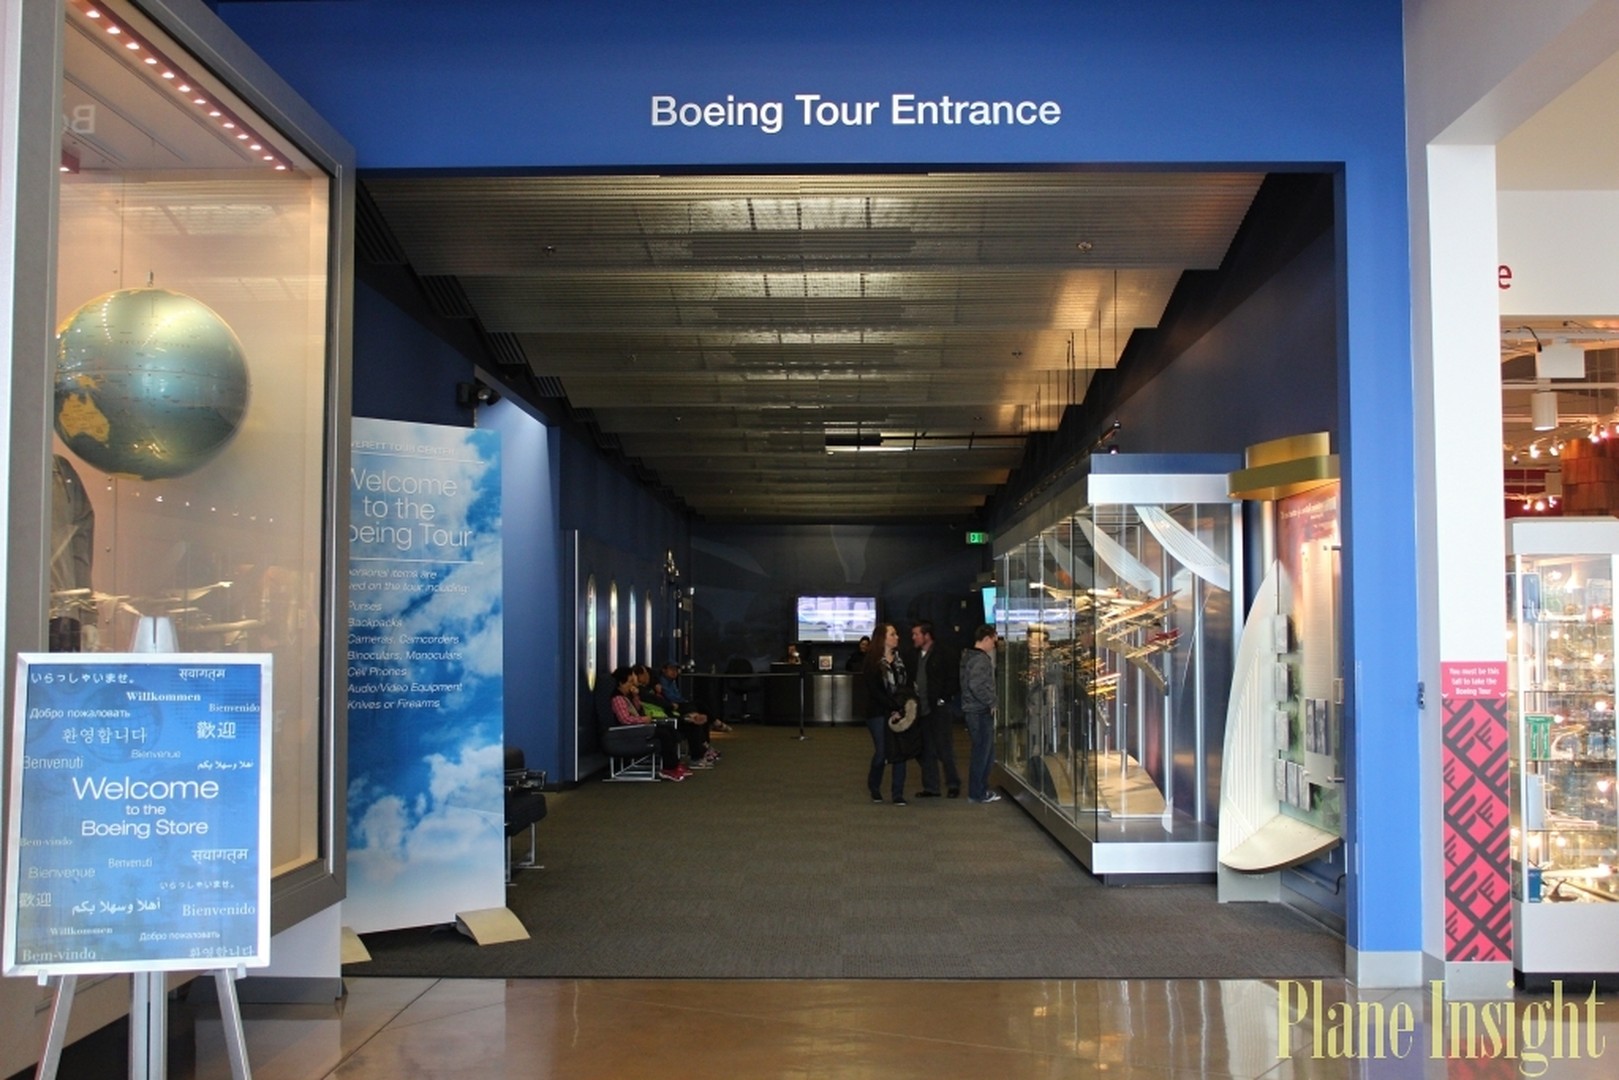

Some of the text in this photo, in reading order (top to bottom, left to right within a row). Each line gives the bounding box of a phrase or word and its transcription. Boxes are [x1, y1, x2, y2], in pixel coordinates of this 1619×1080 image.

[651, 93, 1062, 134] Boeing Tour Entrance
[362, 496, 436, 521] to the
[349, 521, 473, 551] oeing Tour
[410, 683, 462, 694] Equipment
[126, 691, 201, 701] Willkommen
[208, 703, 260, 712] Bienvenido
[62, 727, 147, 744] 환영합니다
[23, 756, 83, 769] Benvenuti
[72, 776, 219, 800] Welcome
[126, 804, 167, 816] to the
[81, 818, 209, 839] Boeing Store
[28, 866, 96, 879] Bienvenue
[182, 903, 256, 917] Bienvenido
[22, 947, 96, 962] Bem-vindo
